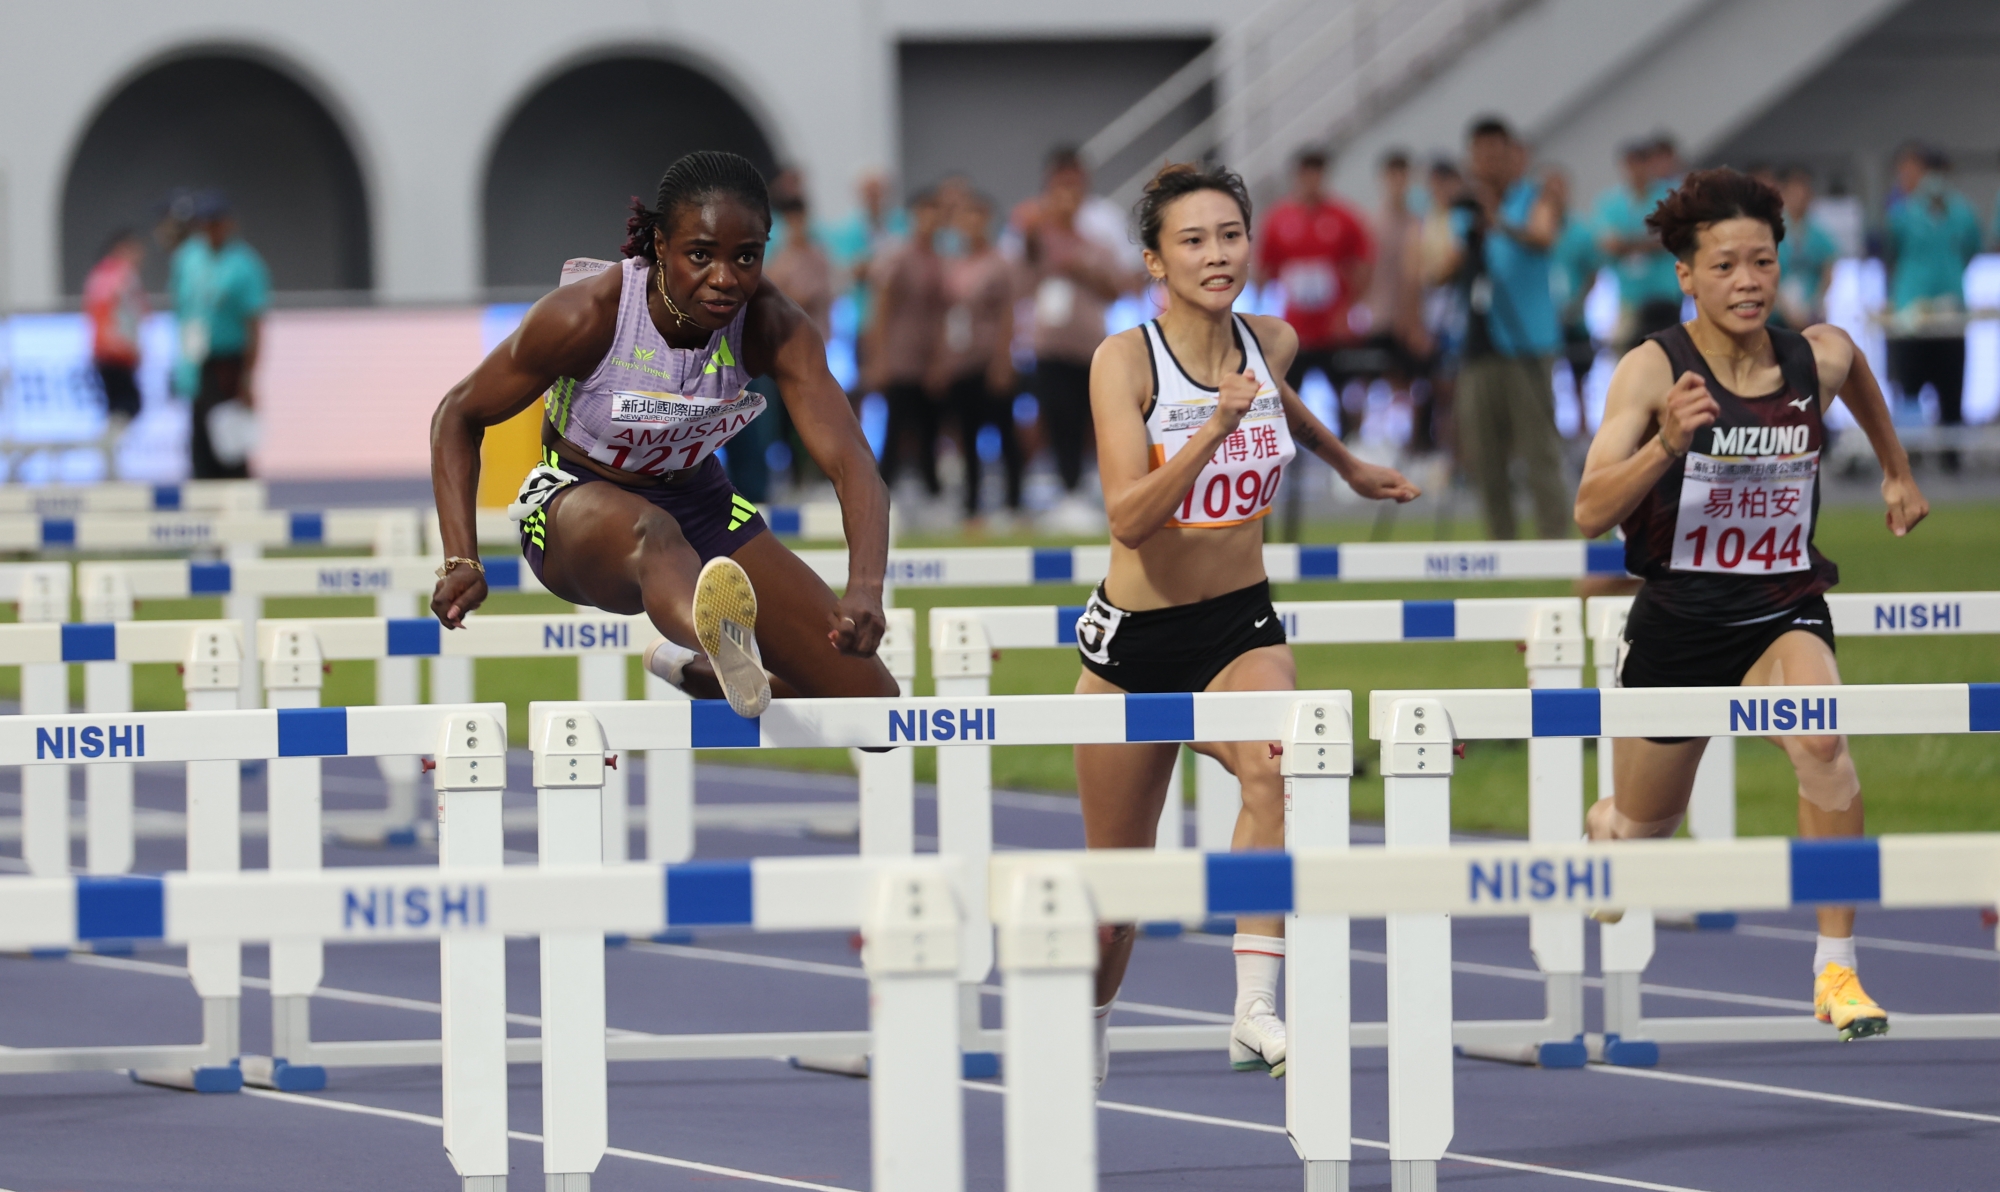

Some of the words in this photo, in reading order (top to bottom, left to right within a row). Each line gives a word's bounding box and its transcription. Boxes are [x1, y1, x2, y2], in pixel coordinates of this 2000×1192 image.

[611, 356, 639, 371] Tirop's
[639, 363, 671, 380] Angels
[613, 411, 756, 446] AMUSAN
[1711, 424, 1810, 455] MIZUNO
[606, 433, 737, 476] 121
[1182, 465, 1281, 519] 1090
[1704, 486, 1800, 519] 易柏安
[1685, 523, 1803, 570] 1044
[1874, 604, 1961, 630] NISHI
[543, 623, 628, 649] NISHI
[889, 708, 995, 742] NISHI
[1729, 697, 1837, 732] NISHI
[36, 724, 145, 760] NISHI
[1469, 859, 1612, 902] NISHI
[343, 887, 486, 929] NISHI
